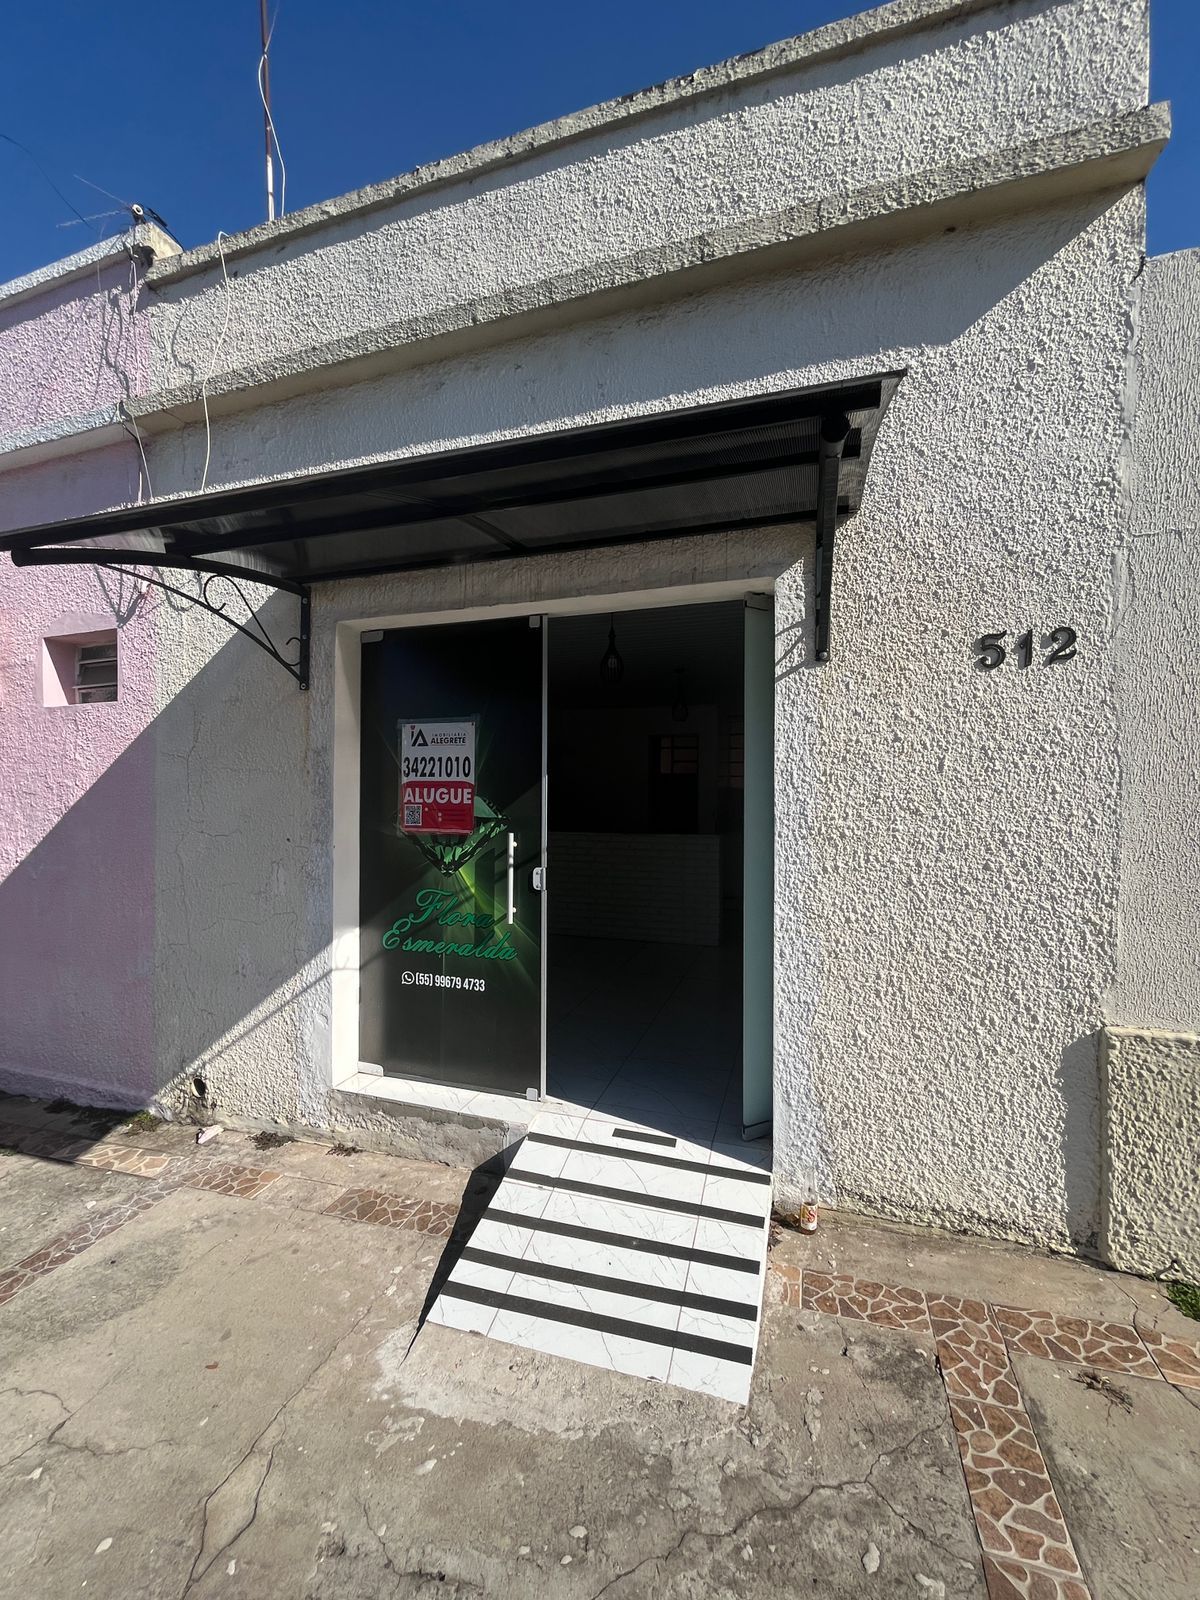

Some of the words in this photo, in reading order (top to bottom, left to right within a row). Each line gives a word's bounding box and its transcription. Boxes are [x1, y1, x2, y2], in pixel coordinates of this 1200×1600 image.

[977, 626, 1077, 670] 512
[430, 737, 466, 745] ALEGRETE
[403, 756, 471, 778] 34221010
[403, 787, 472, 804] ALUGUE
[410, 888, 494, 928] Flora
[382, 918, 517, 961] Esmeralda
[415, 972, 433, 986] (55)
[434, 974, 462, 990] 99679
[463, 978, 485, 992] 4733
